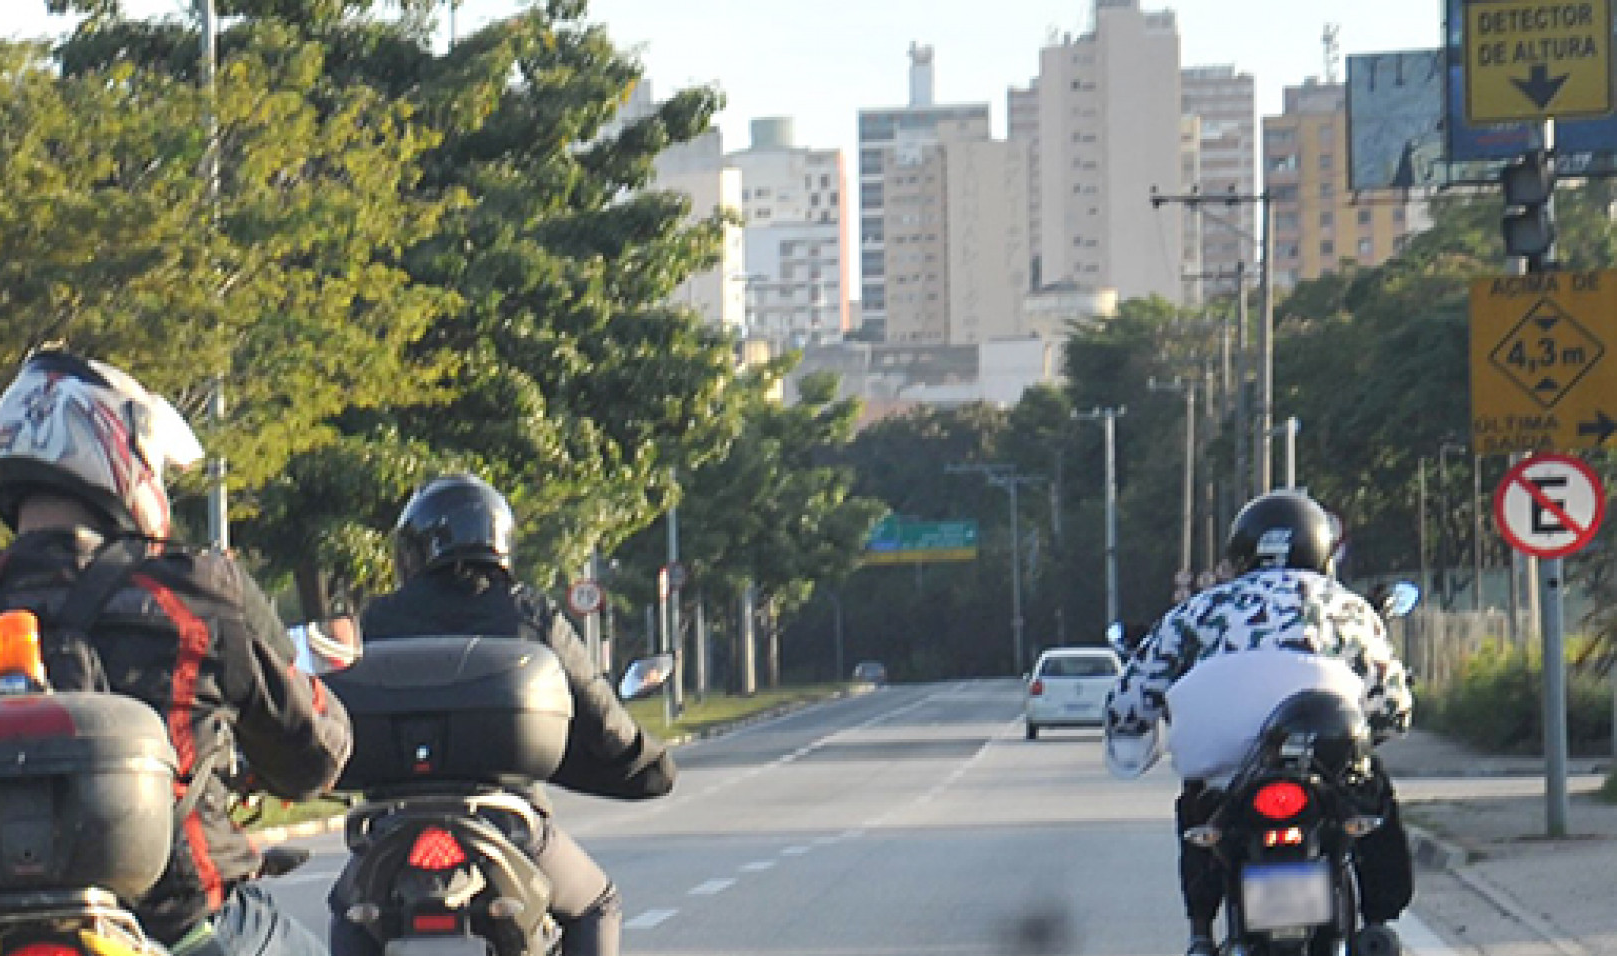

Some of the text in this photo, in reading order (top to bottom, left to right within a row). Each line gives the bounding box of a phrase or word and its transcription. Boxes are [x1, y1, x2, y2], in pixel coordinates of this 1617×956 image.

[1478, 3, 1593, 35] DETECTOR
[1478, 35, 1599, 66] DE ALTURA
[1490, 271, 1599, 297] ACIMA DE
[1531, 475, 1568, 534] E
